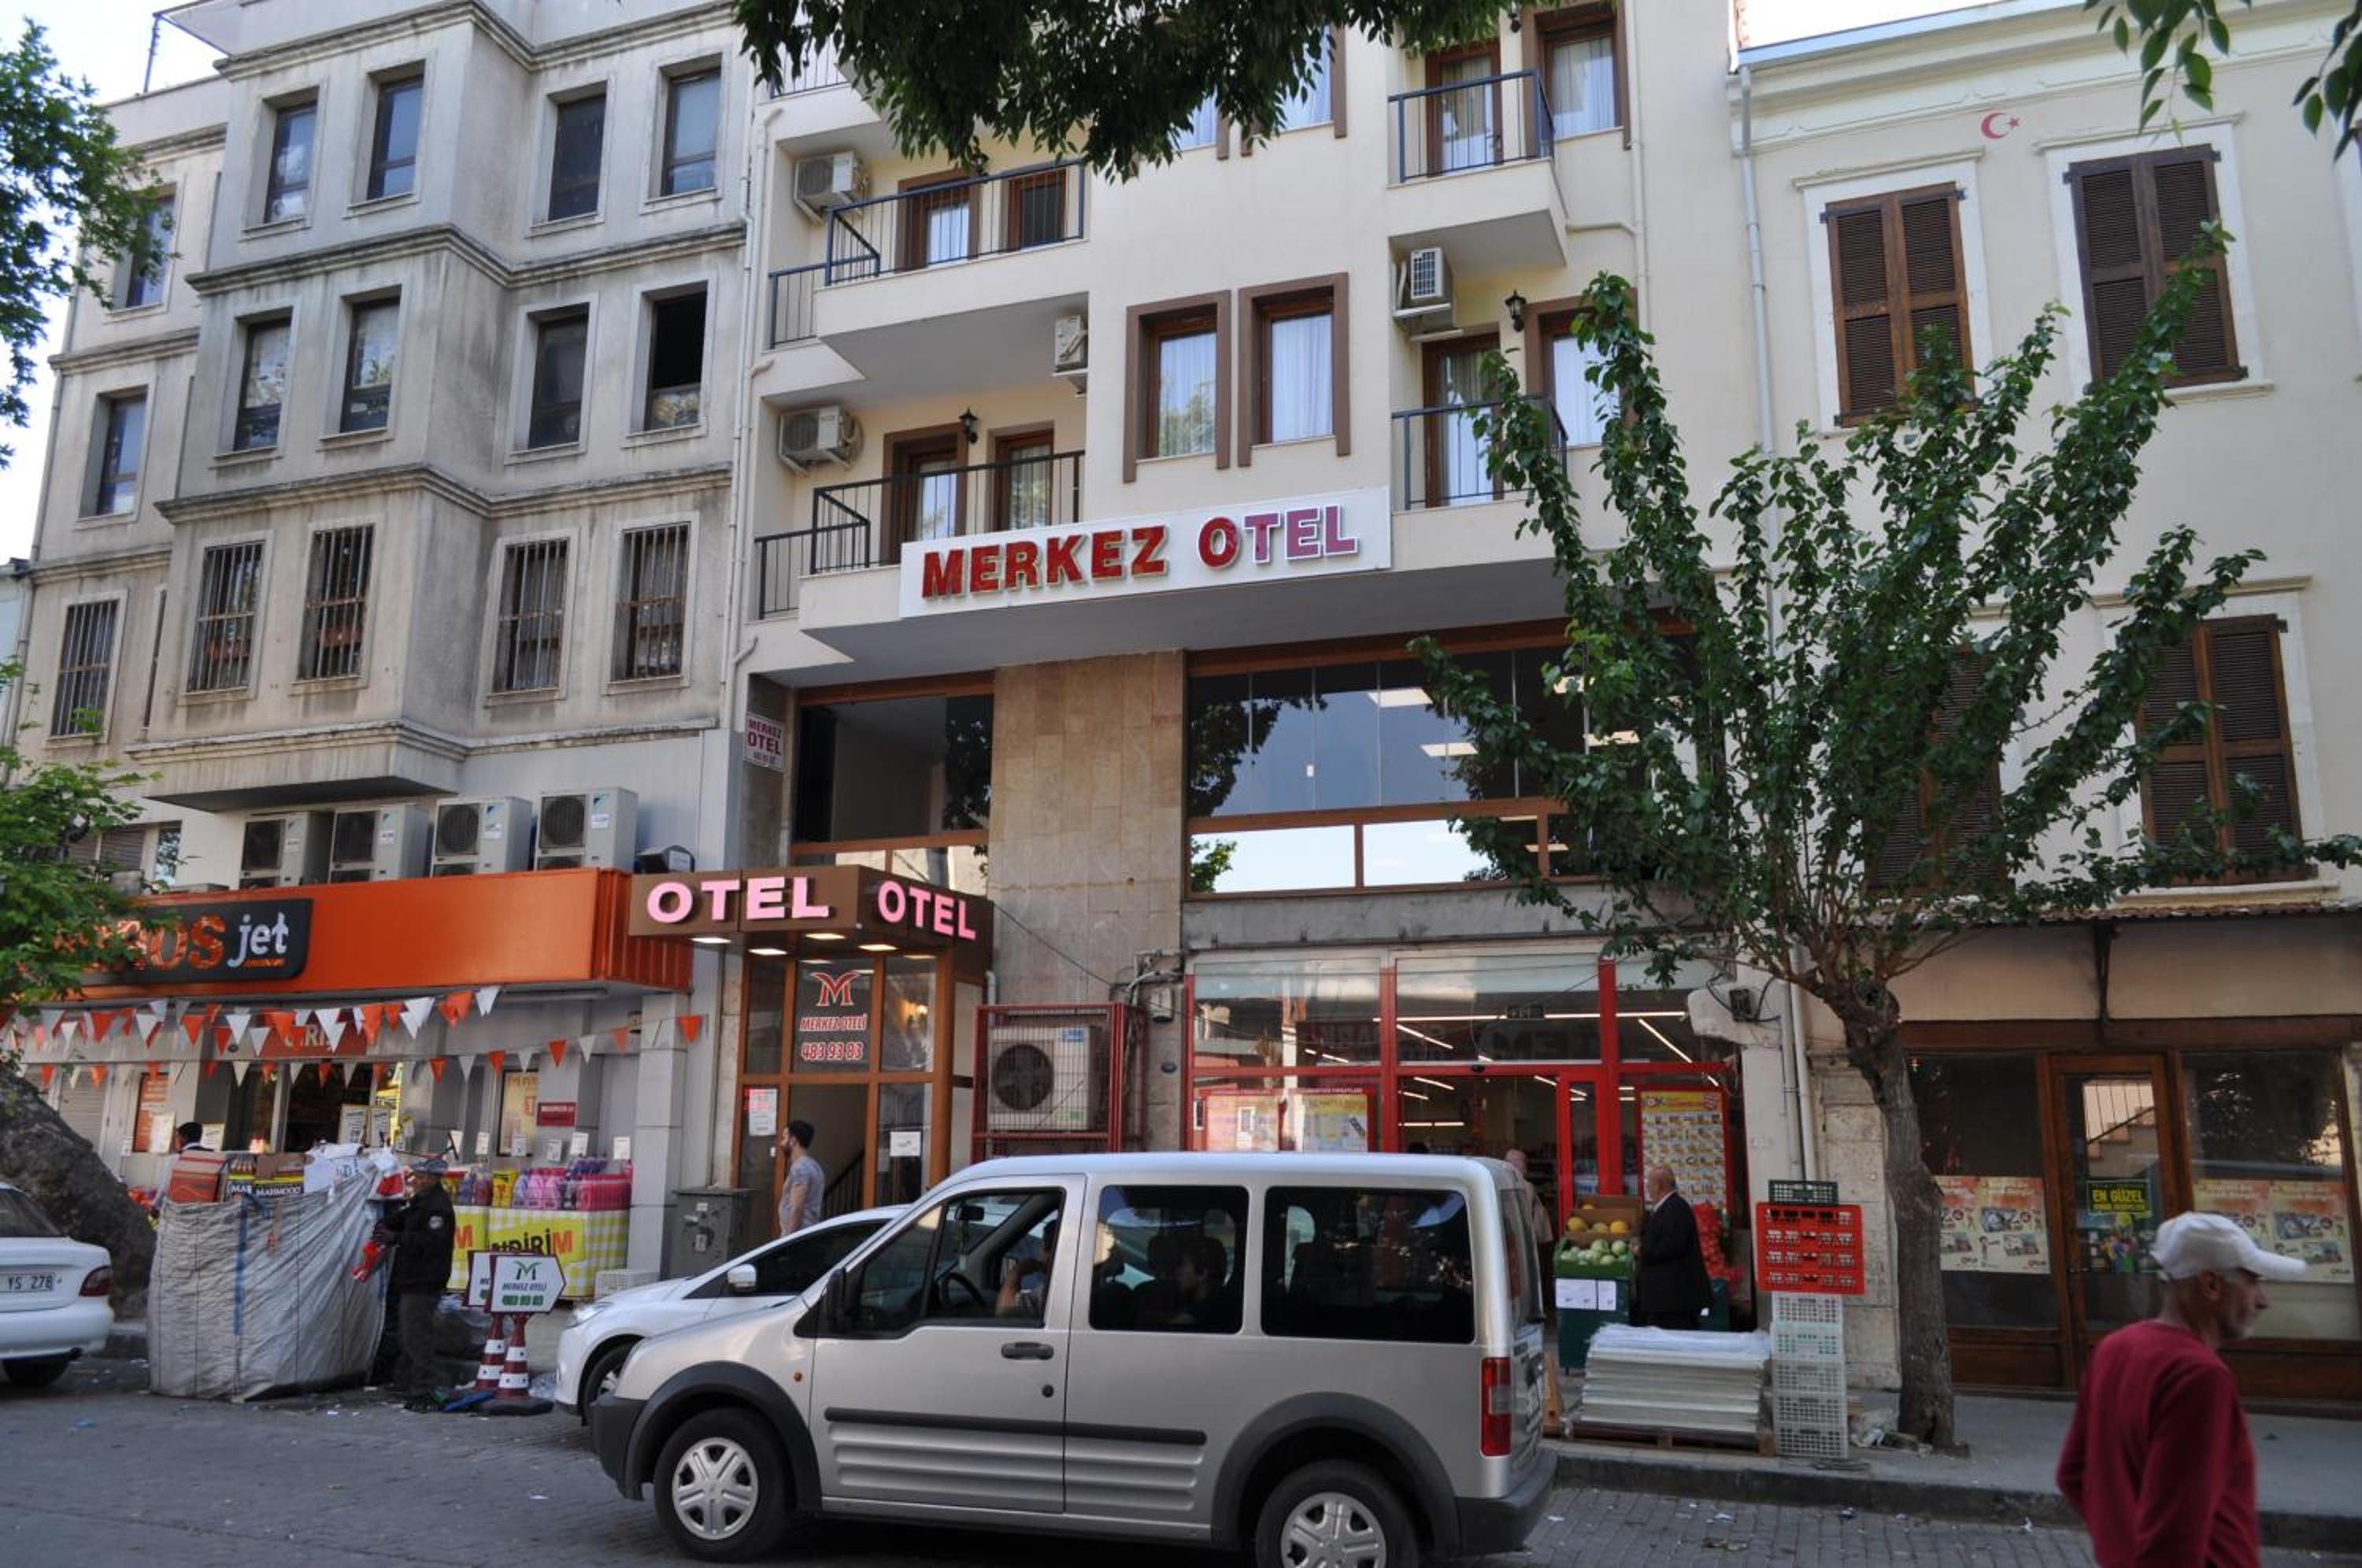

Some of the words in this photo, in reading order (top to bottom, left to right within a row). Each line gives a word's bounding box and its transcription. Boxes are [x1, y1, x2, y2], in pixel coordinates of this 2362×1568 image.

[921, 524, 1169, 600] MERKEZ
[1198, 505, 1359, 569] OTEL
[747, 731, 782, 756] OTEL
[748, 717, 782, 739] MERKEZ
[646, 877, 830, 924] OTEL
[877, 880, 977, 941] OTEL
[228, 912, 289, 968] jet
[800, 1017, 839, 1032] MERKEZ
[802, 1041, 826, 1061] 483
[827, 1041, 845, 1060] 93
[846, 1041, 864, 1060] 83
